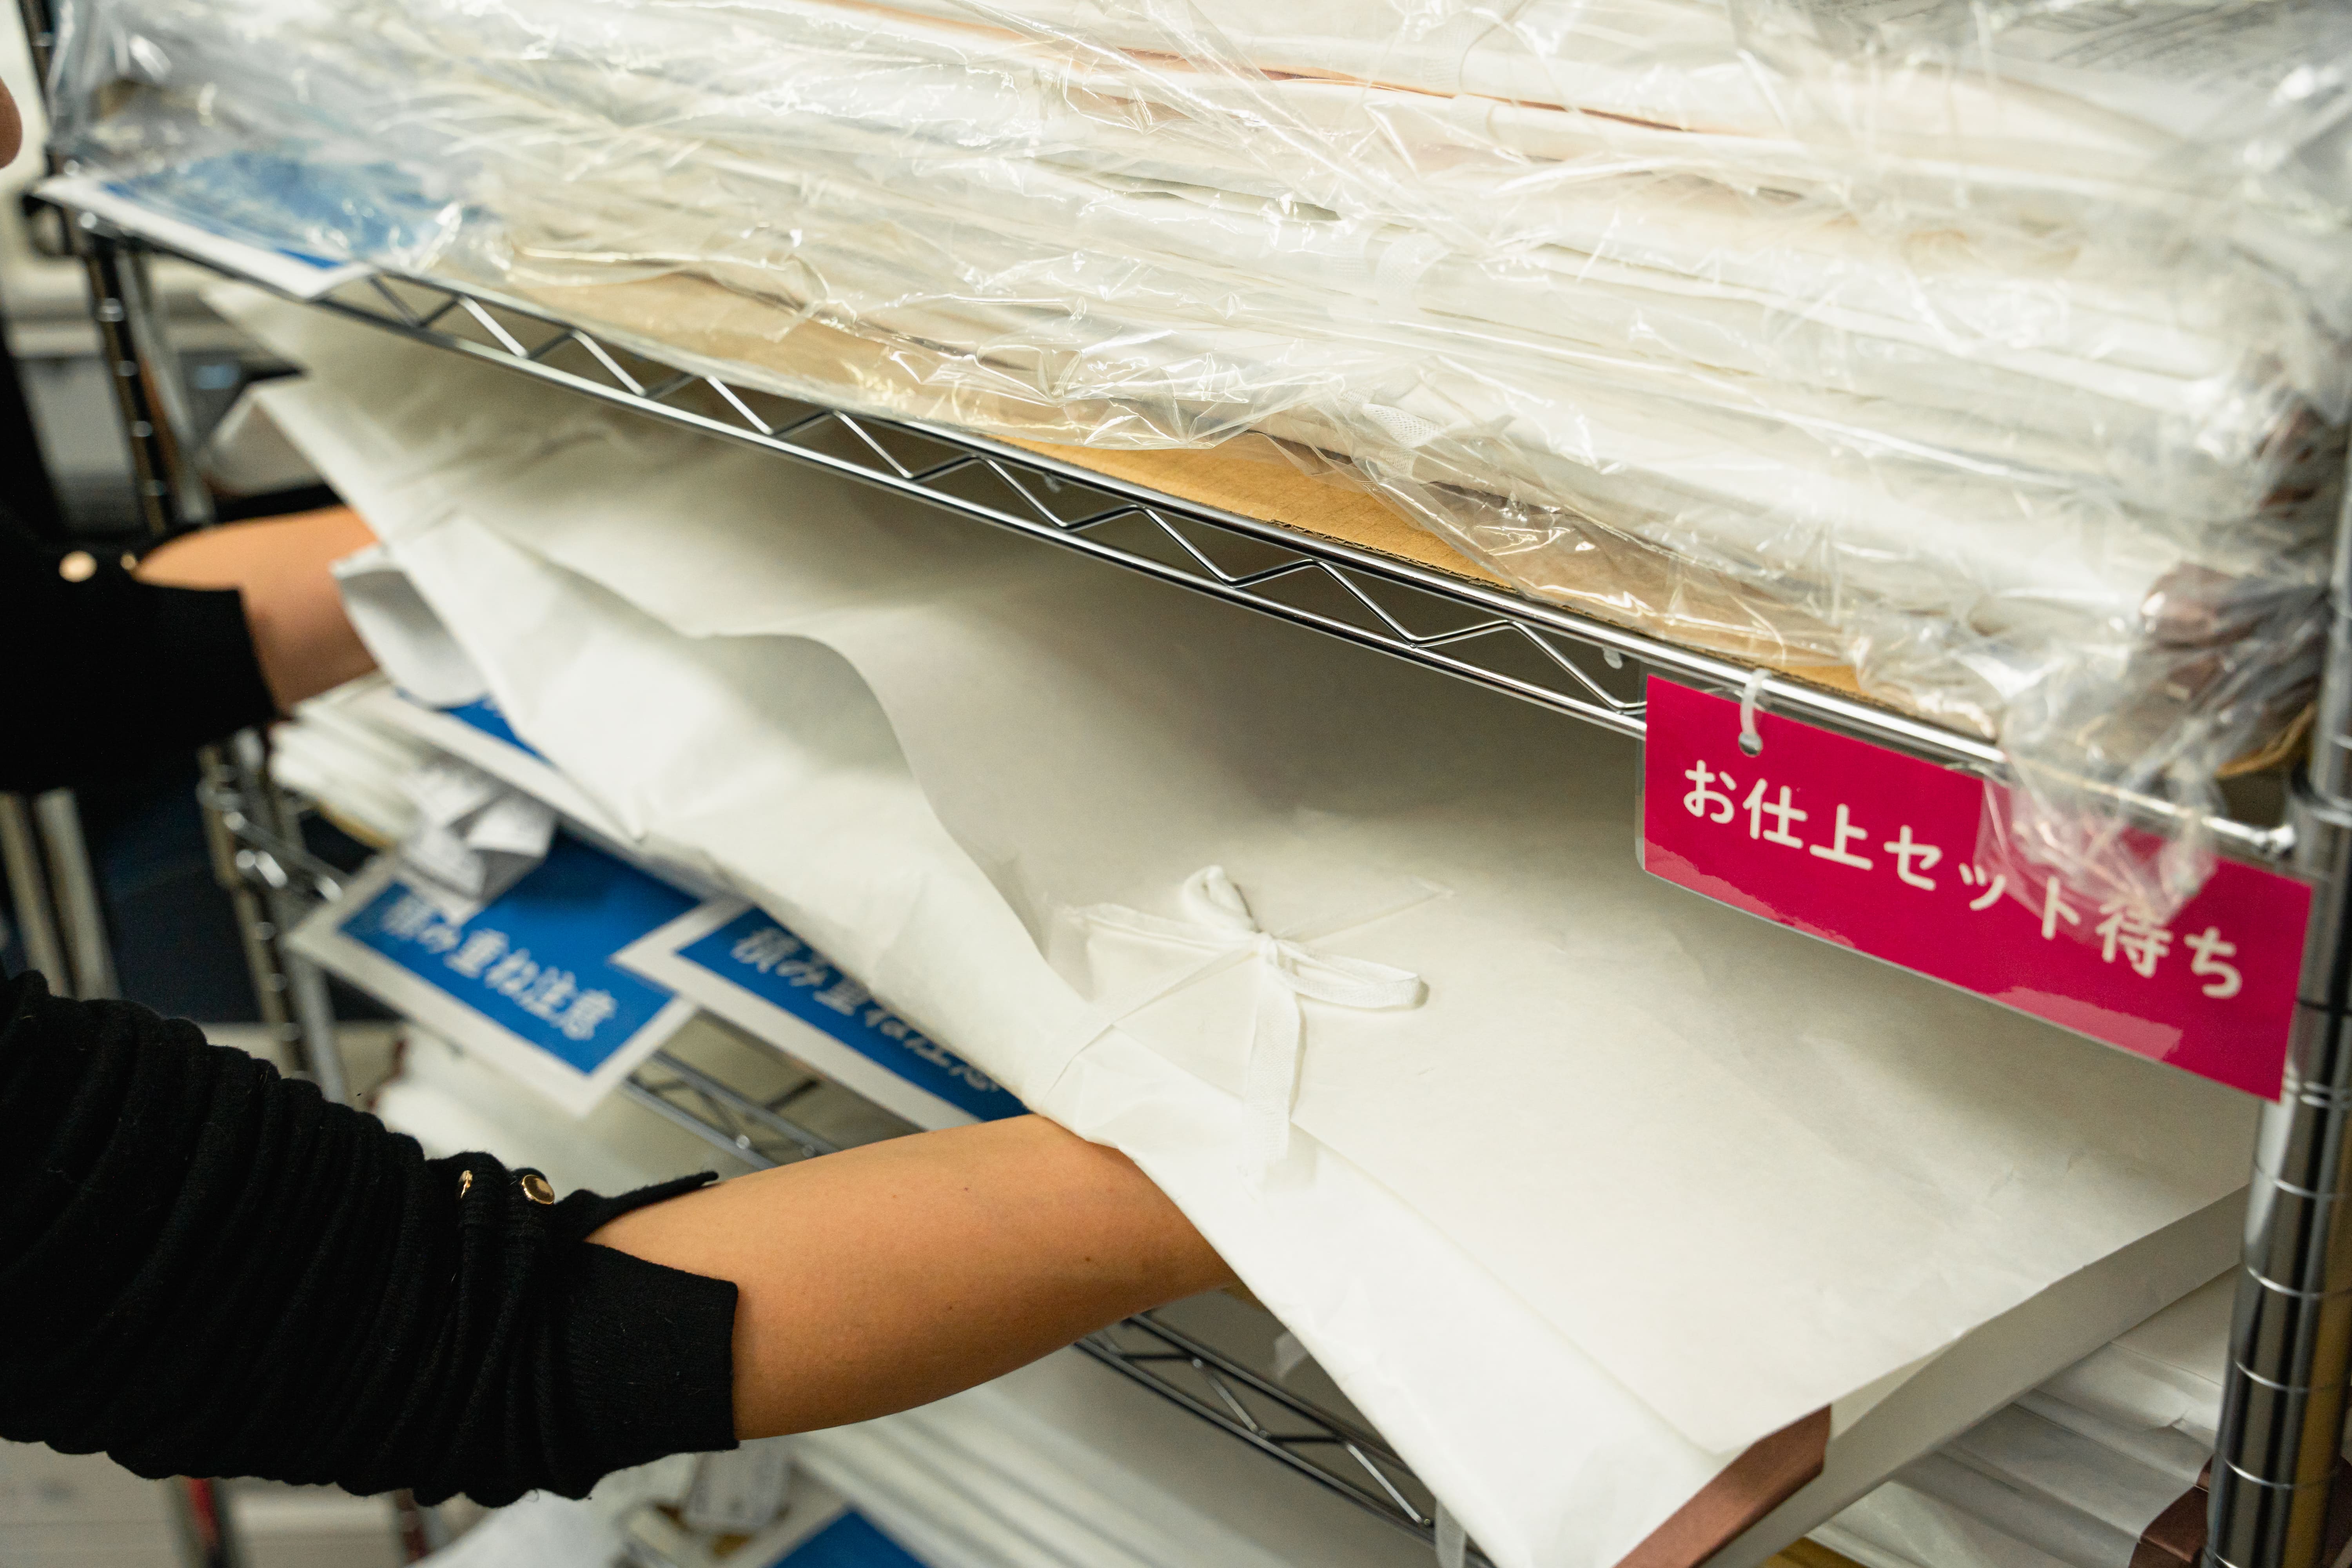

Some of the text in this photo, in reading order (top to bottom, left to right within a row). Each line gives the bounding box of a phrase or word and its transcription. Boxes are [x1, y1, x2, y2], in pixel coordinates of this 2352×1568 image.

[1684, 759, 2242, 998] お仕上セット待ち
